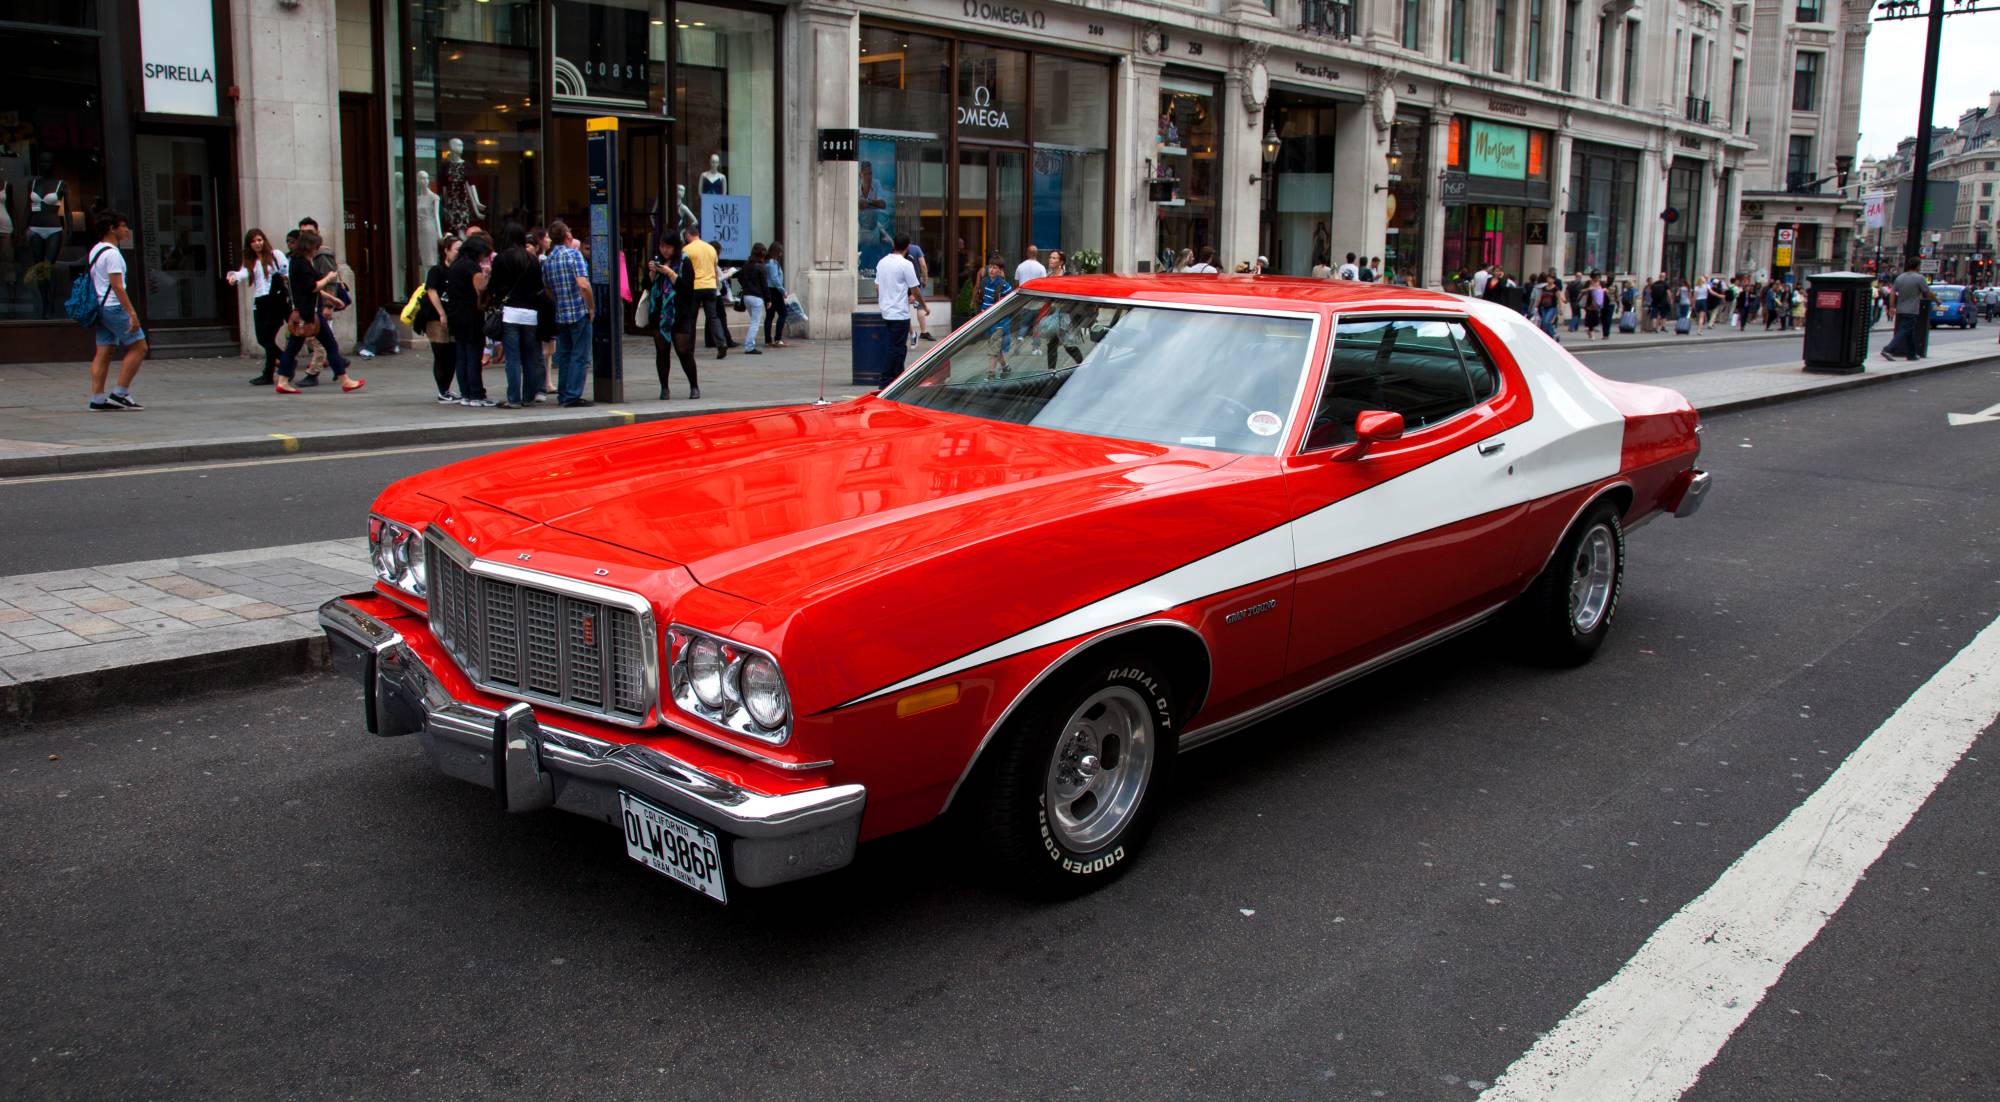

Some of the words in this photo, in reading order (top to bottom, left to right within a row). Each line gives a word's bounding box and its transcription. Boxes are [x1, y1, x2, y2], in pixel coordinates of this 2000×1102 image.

[980, 3, 1029, 26] OMEGA
[1088, 24, 1104, 36] 260
[145, 63, 213, 83] SPIRELLA
[585, 61, 645, 79] coast
[957, 107, 1009, 129] OMEGA
[823, 139, 853, 150] coast
[1475, 129, 1516, 163] Monsoon
[713, 203, 739, 215] SALE
[1107, 668, 1158, 696] RADIAL
[644, 808, 690, 837] CALIFORNIA
[1039, 793, 1060, 861] COBRA
[1062, 846, 1125, 874] COOPER
[652, 858, 671, 874] GRAN
[673, 867, 697, 886] TORINO
